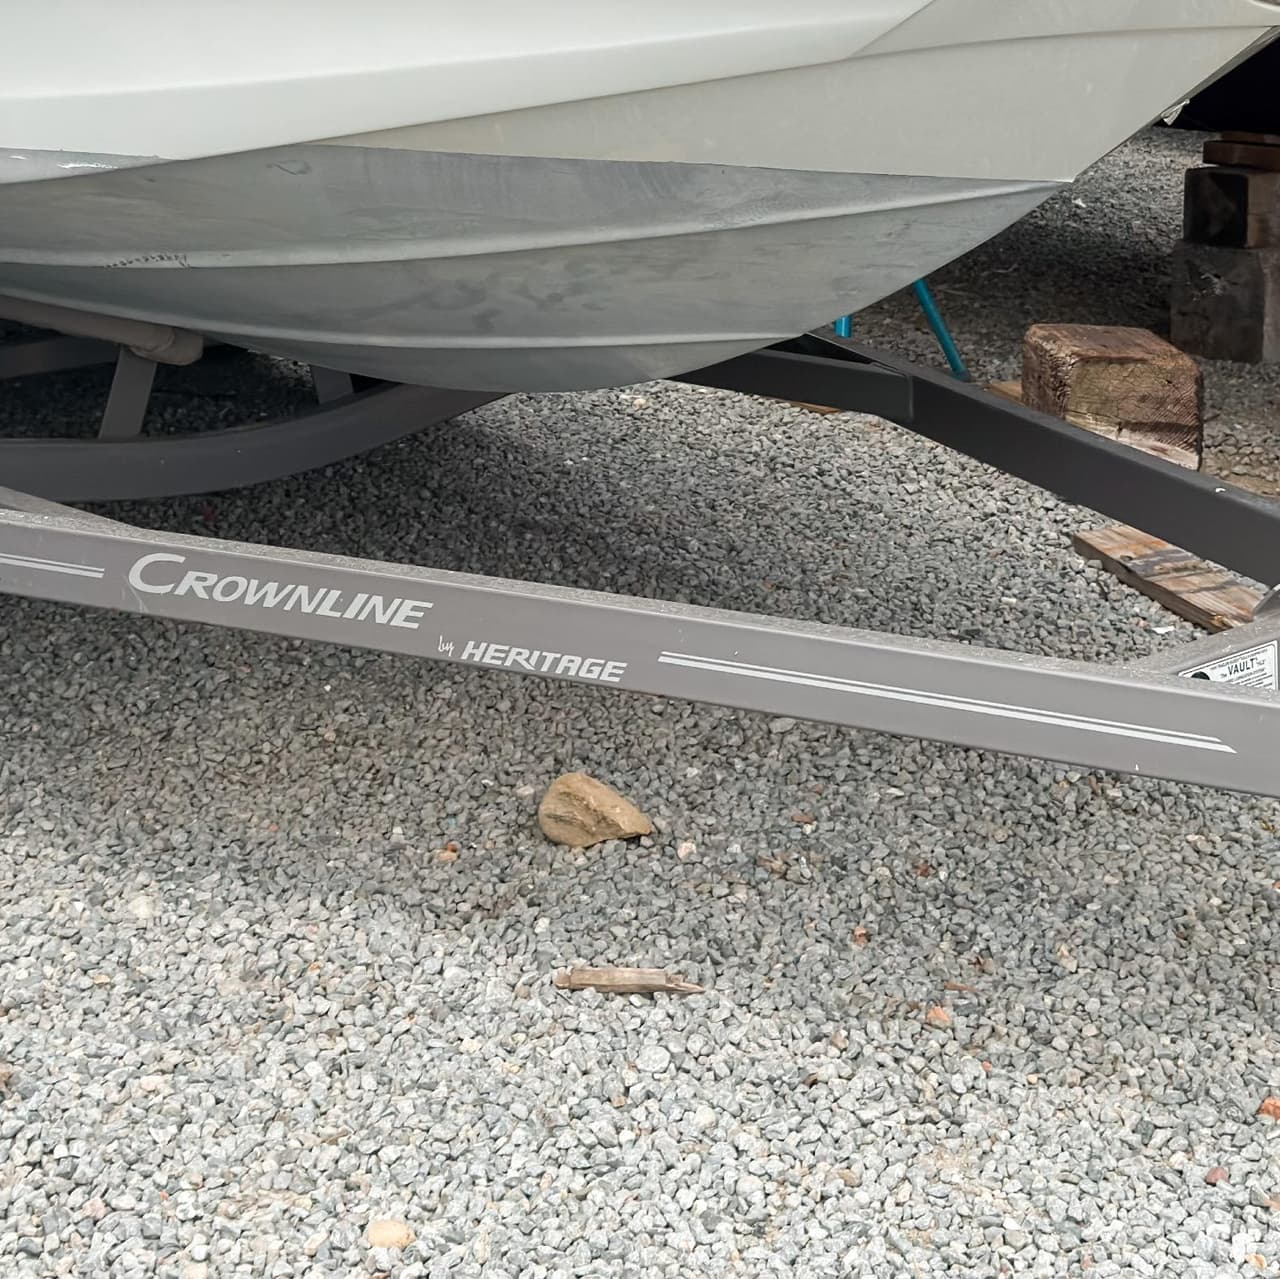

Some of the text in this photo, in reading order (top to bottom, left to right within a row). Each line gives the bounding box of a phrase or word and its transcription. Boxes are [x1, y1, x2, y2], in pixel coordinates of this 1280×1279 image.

[128, 552, 434, 630] CROWNLINE
[437, 634, 628, 683] by HERITAGE
[1227, 657, 1256, 677] VAULT
